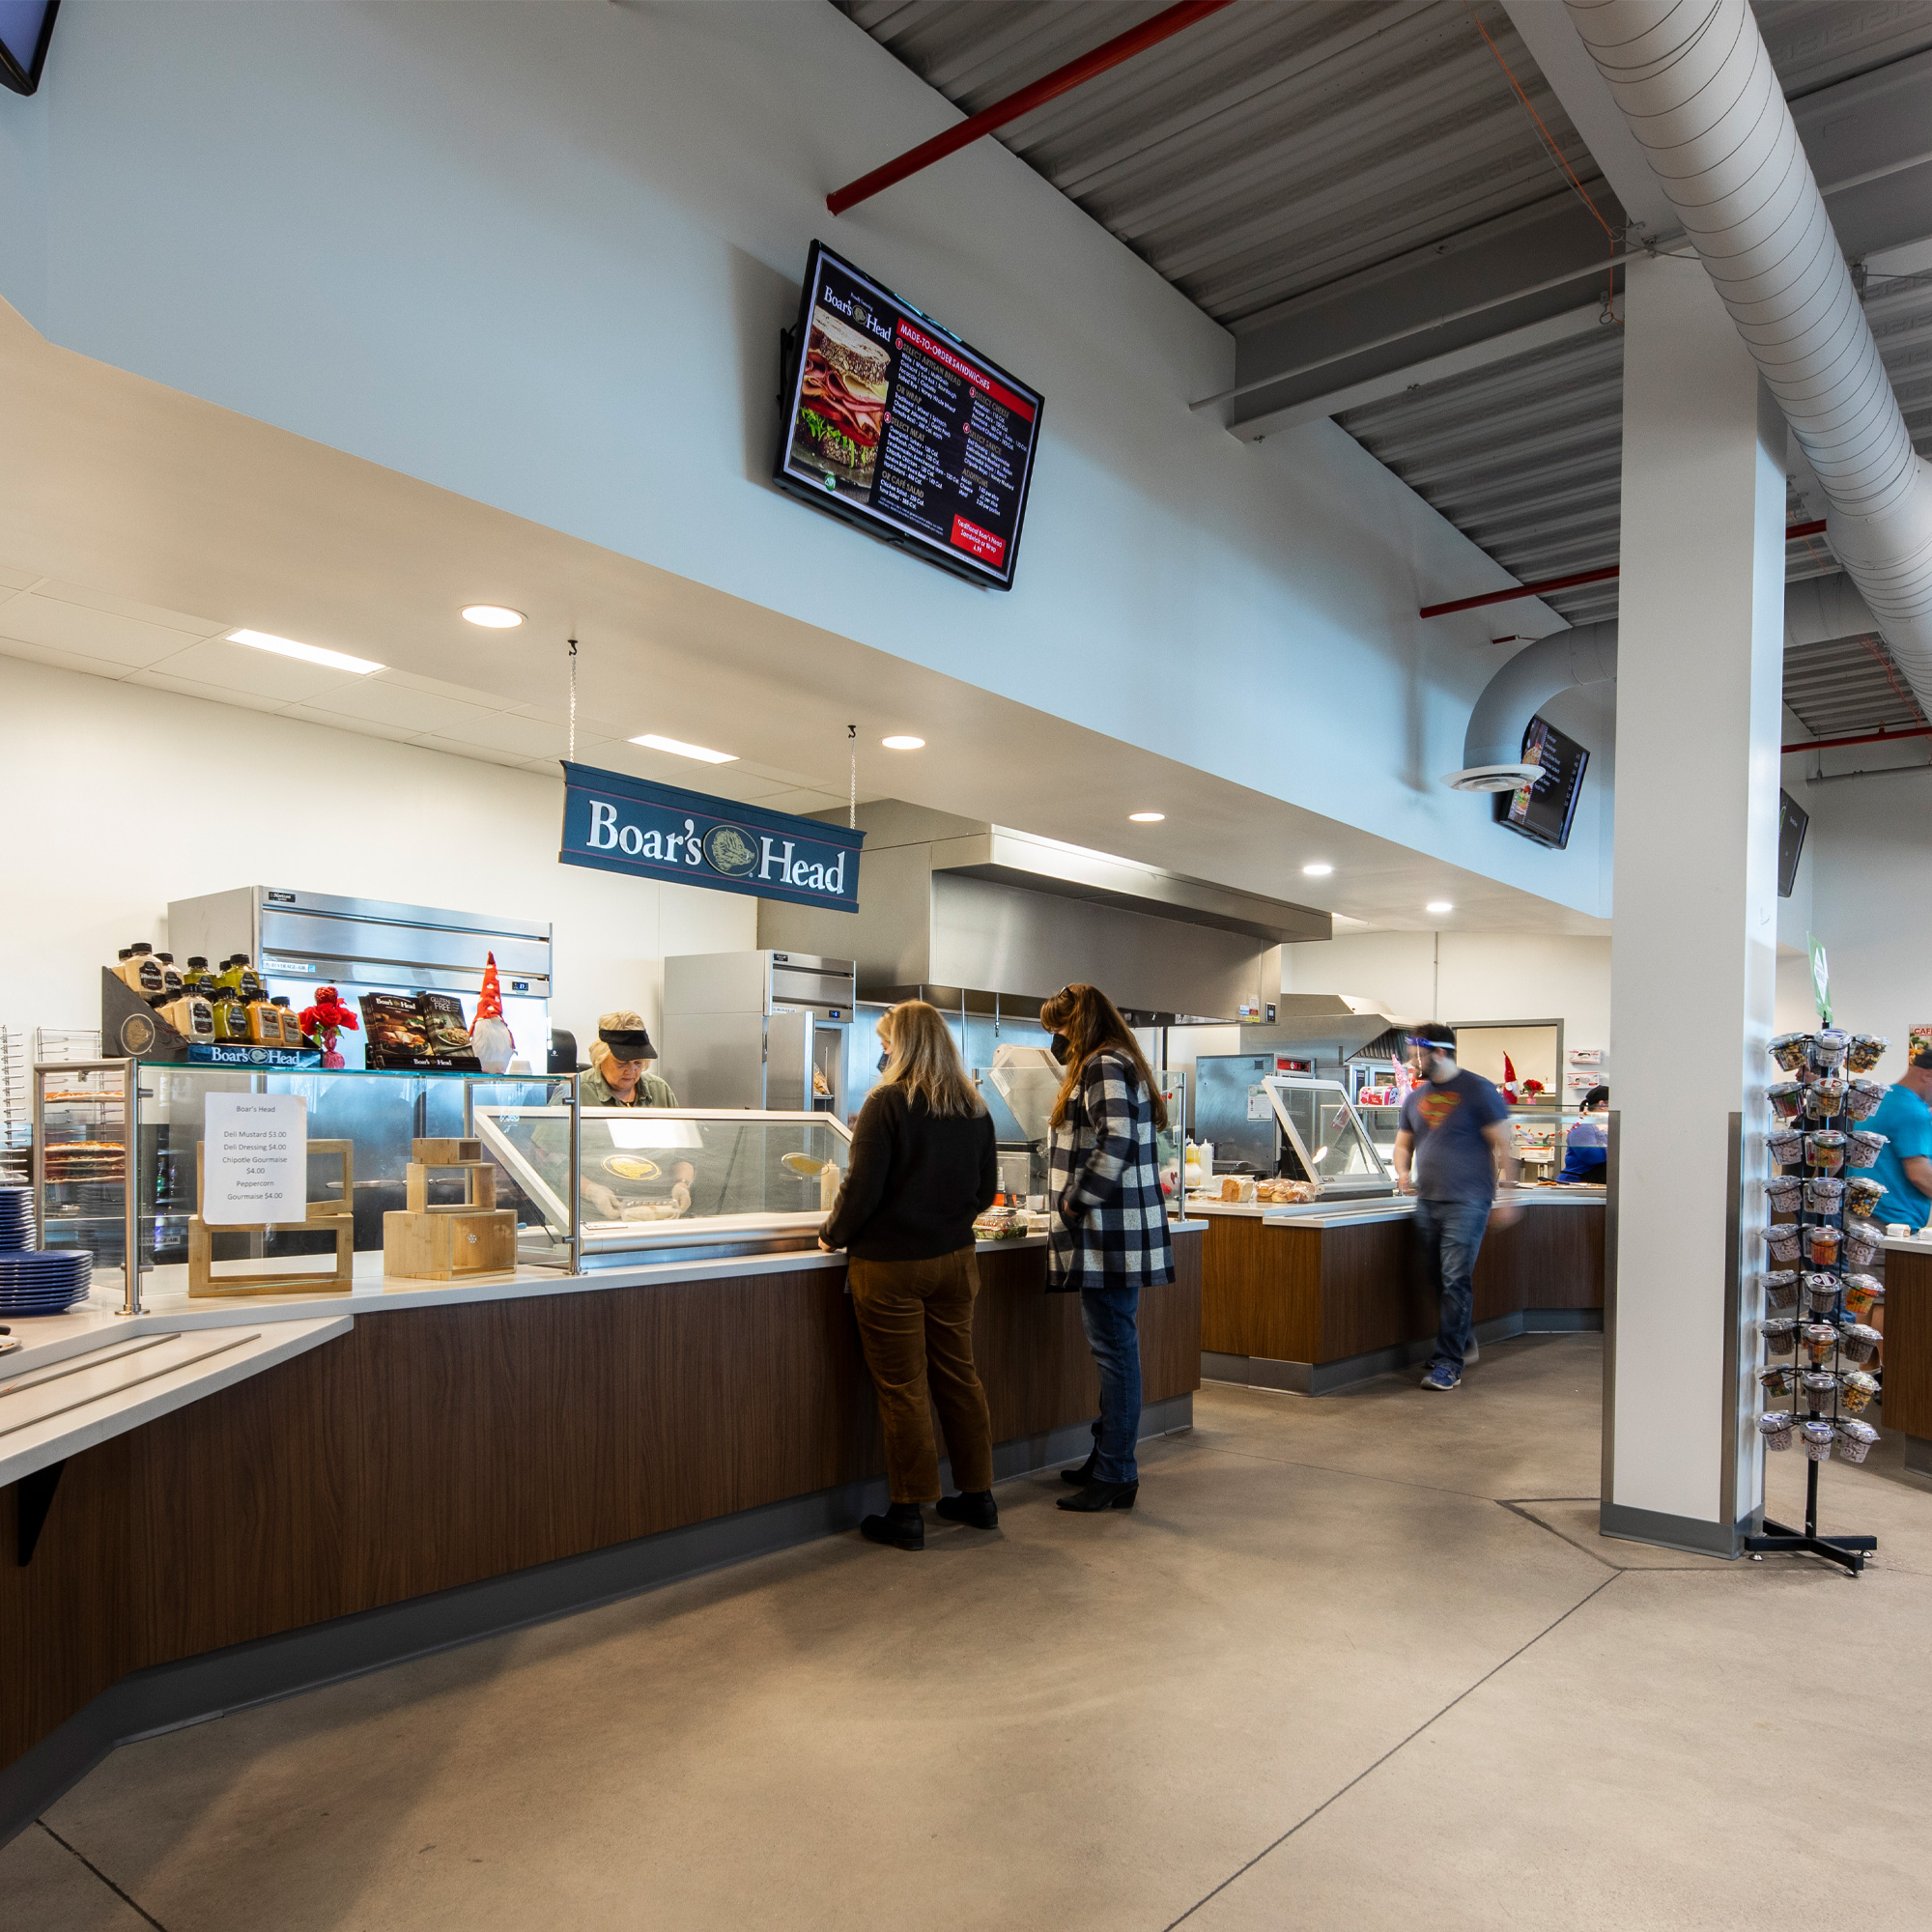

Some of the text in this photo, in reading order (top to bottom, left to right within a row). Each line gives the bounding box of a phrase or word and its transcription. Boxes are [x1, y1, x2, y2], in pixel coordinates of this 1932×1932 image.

[824, 285, 891, 342] Boar's Head
[901, 324, 990, 391] MADE-TO-ORDER SANDWICHES
[910, 428, 924, 441] MEAT
[586, 800, 846, 895] Boar's Head
[401, 1001, 416, 1010] Head
[434, 1002, 451, 1012] FREE
[212, 1047, 300, 1064] Boar's Head
